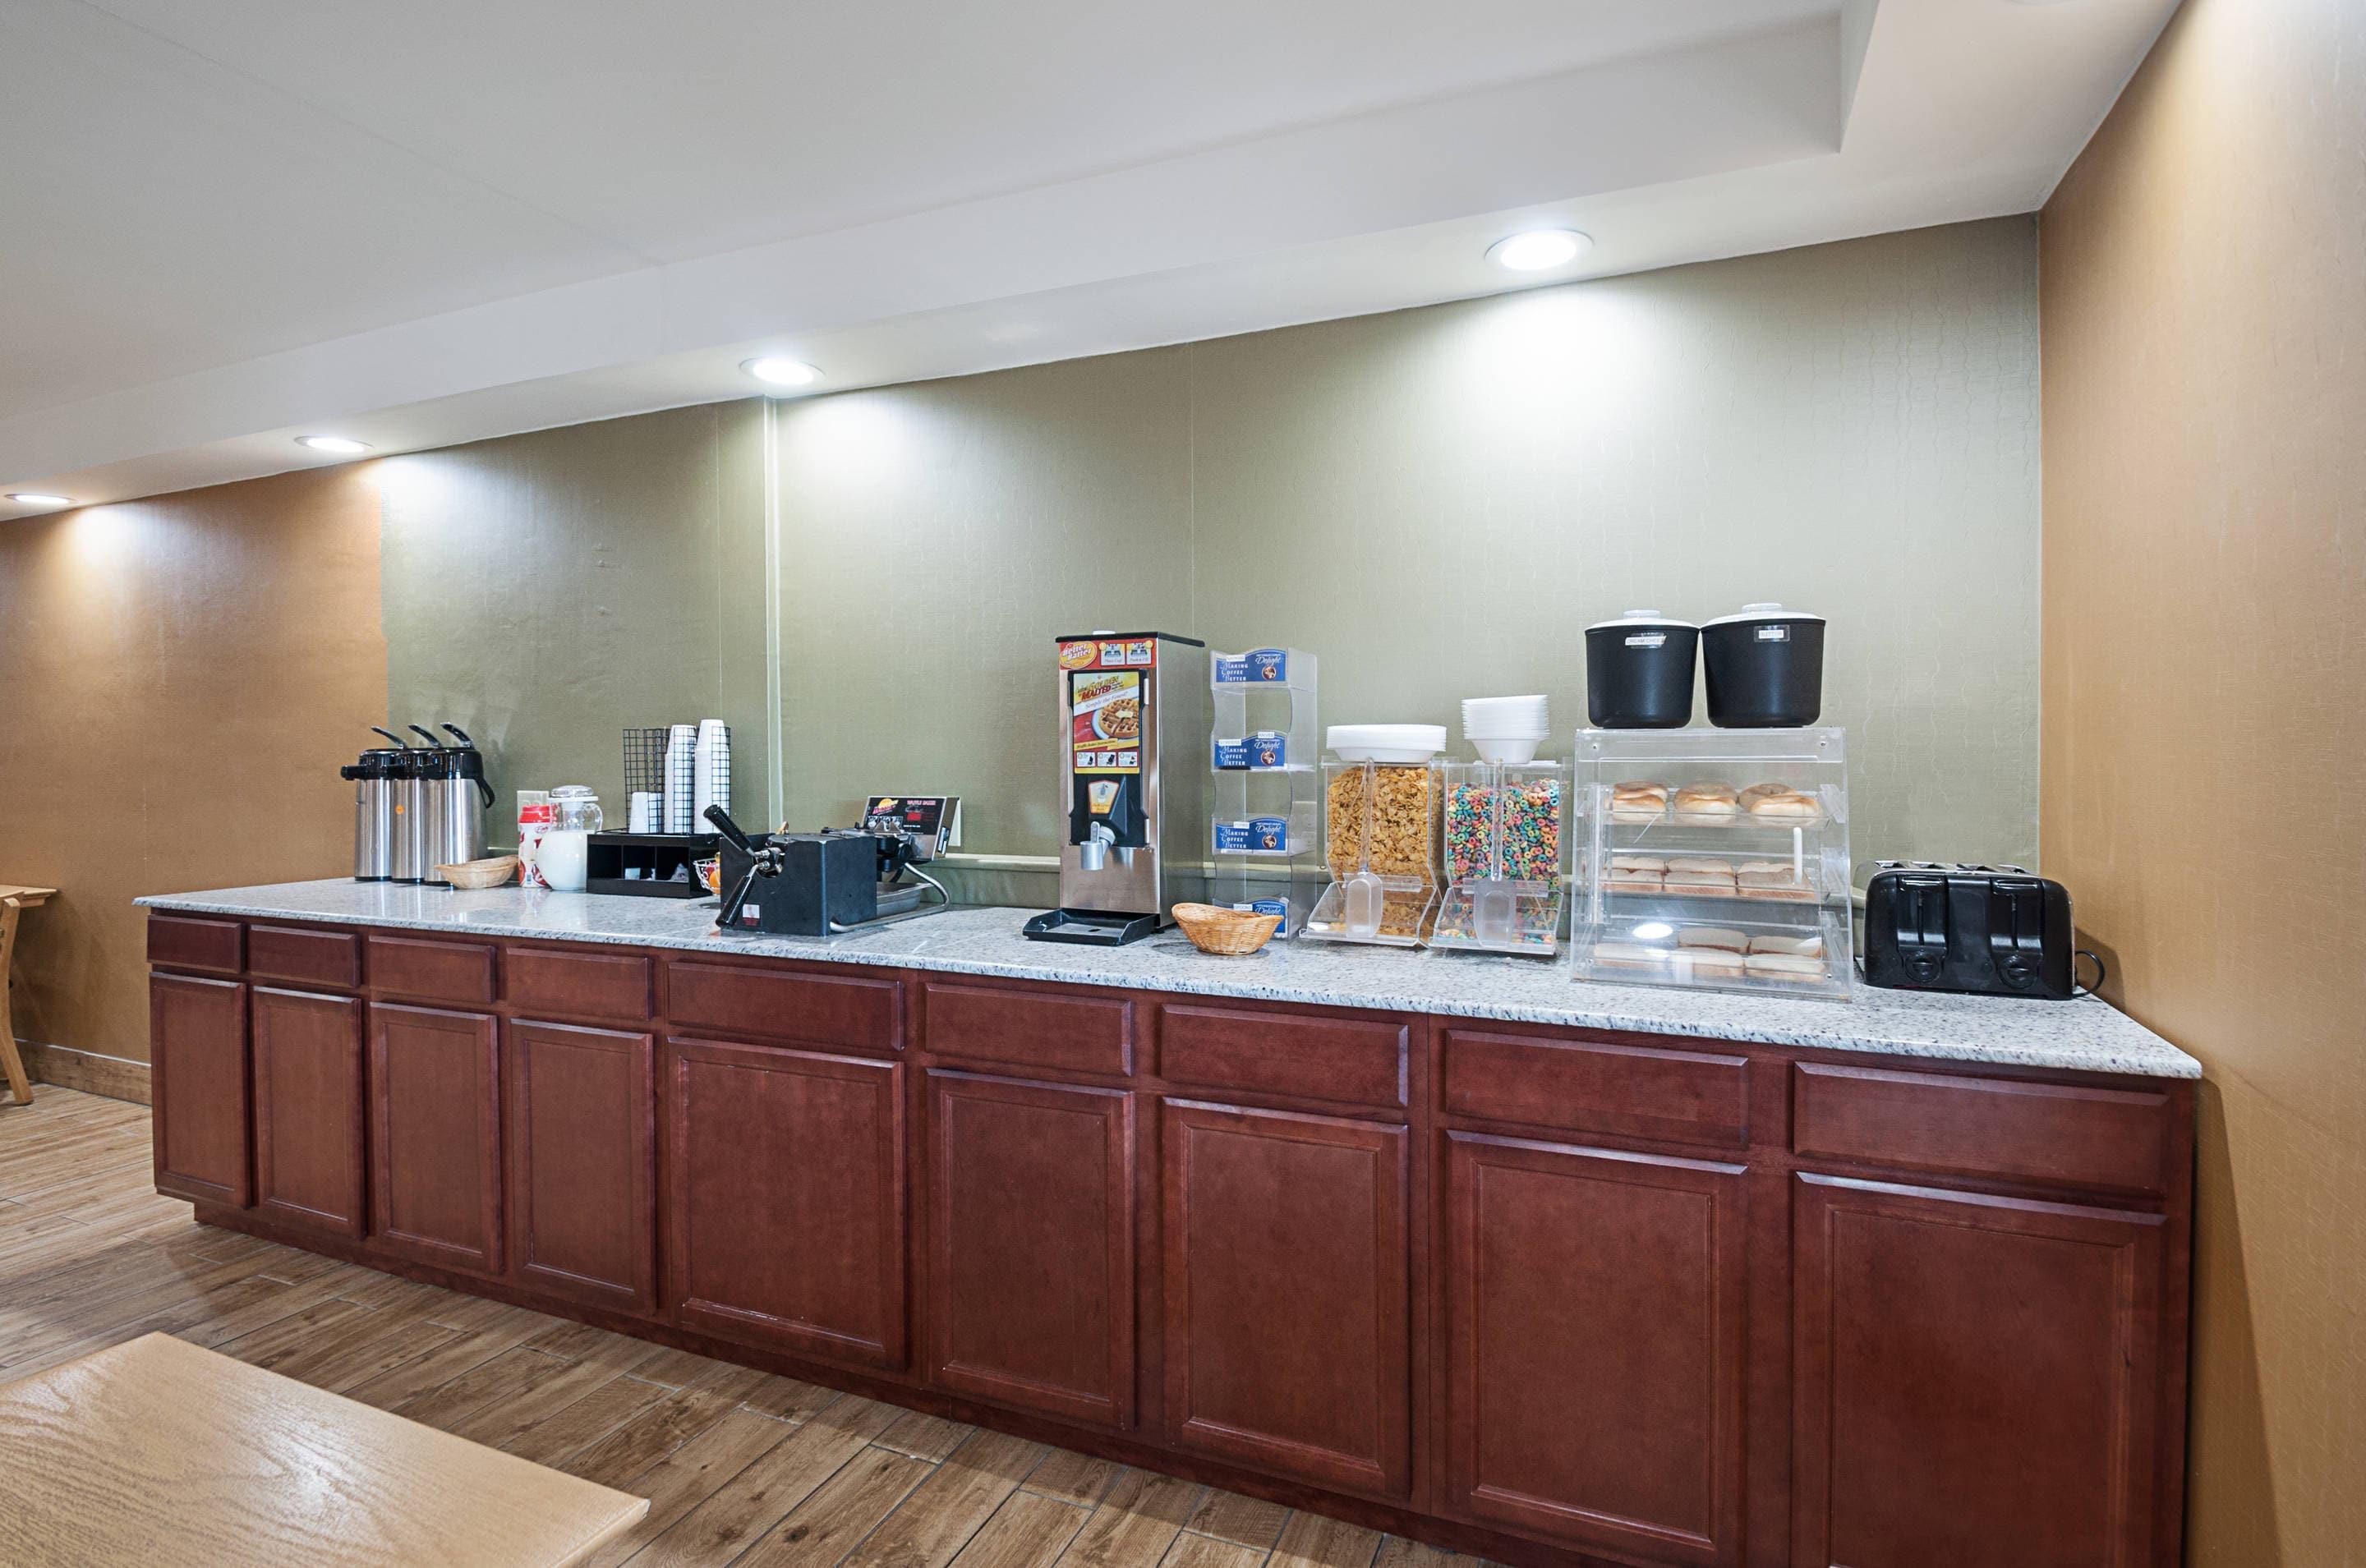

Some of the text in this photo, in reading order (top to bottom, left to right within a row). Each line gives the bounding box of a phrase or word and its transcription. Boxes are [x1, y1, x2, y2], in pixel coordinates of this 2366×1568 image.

[1255, 657, 1282, 667] Delight
[1082, 685, 1112, 701] MALTED
[1254, 742, 1281, 752] Delight
[1221, 828, 1249, 836] MAKING
[1255, 825, 1282, 835] Delight
[1255, 907, 1281, 915] Delight
